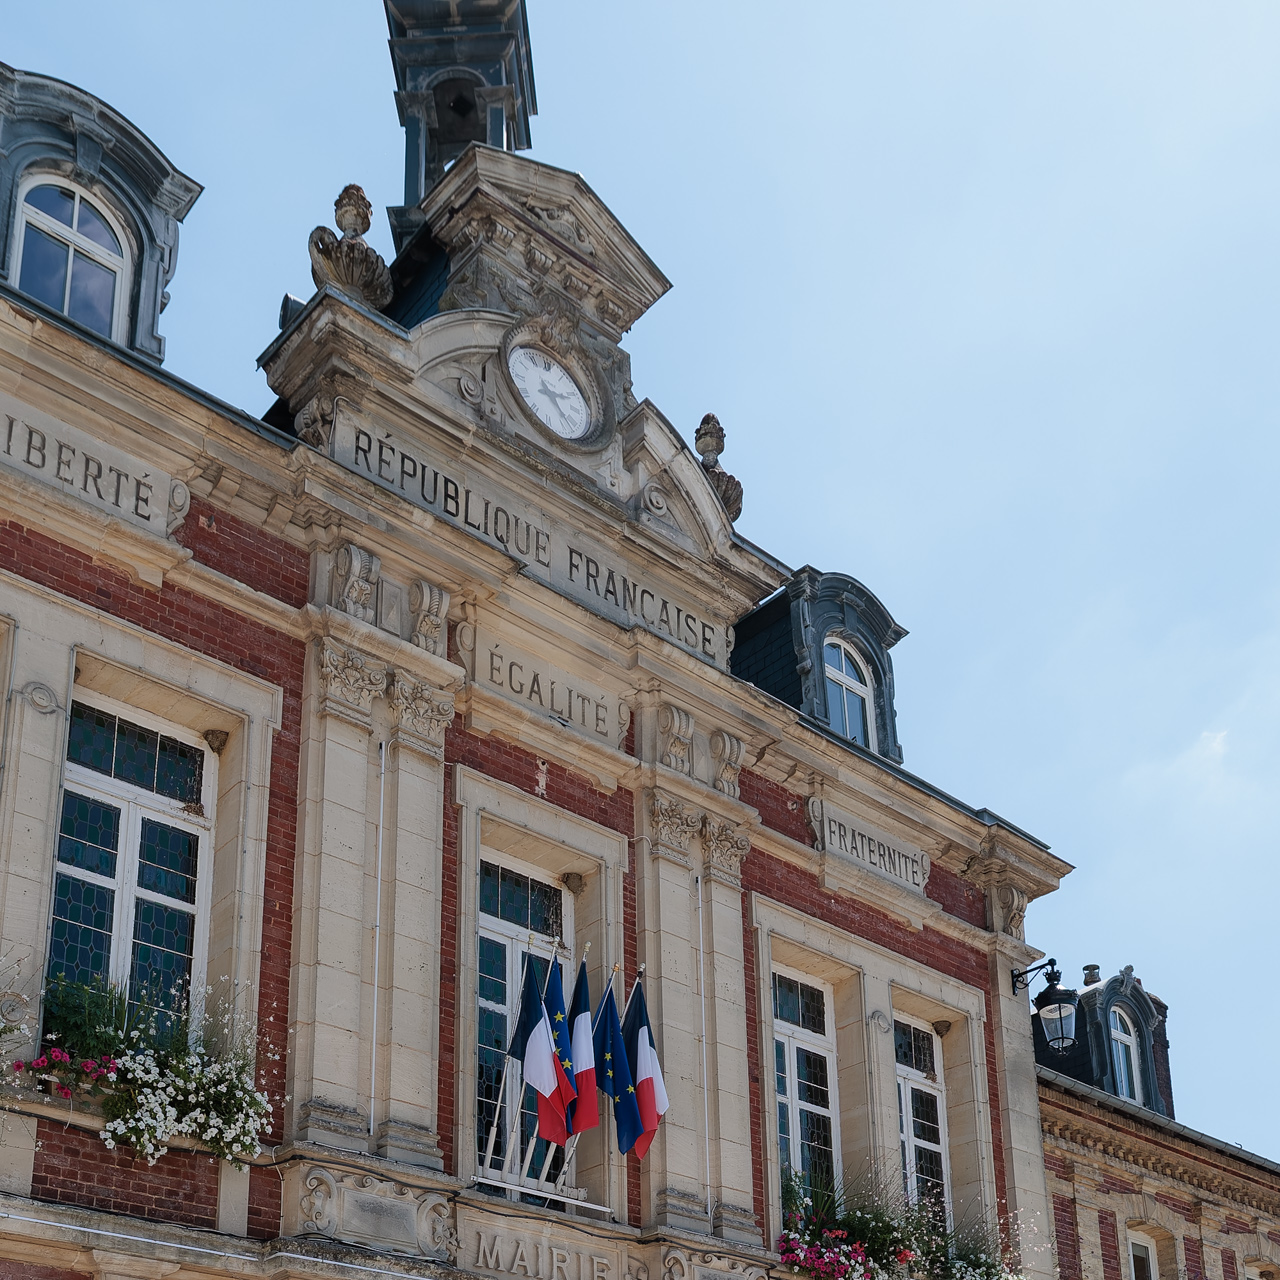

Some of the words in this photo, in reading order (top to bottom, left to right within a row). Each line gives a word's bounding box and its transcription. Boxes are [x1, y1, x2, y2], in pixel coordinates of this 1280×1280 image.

[354, 428, 551, 568] RÉPUBLIQUE
[488, 643, 609, 737] ÉGALITÉ
[827, 816, 920, 887] FRATERNITÉ
